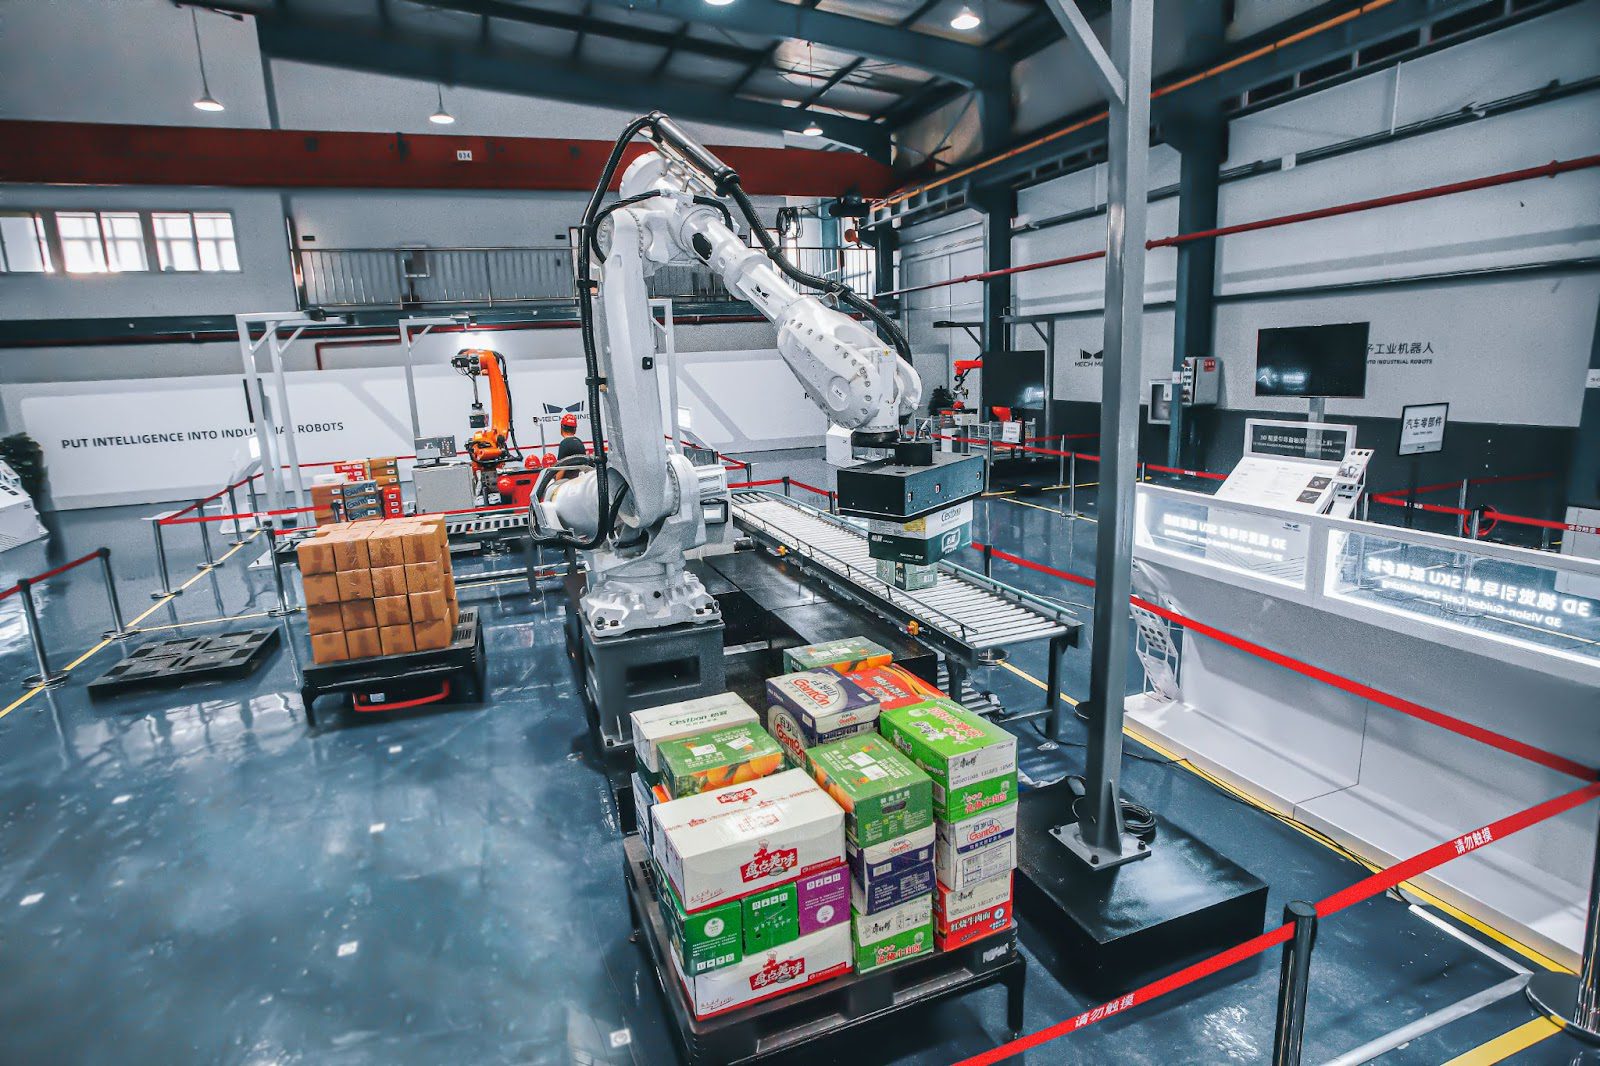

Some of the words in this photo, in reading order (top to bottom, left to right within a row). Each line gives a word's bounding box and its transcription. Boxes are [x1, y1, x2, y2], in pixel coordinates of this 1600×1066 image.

[61, 438, 89, 449] PUT
[92, 432, 184, 448] INTELLIGENCE
[187, 430, 218, 441] INTO
[297, 421, 344, 434] ROBOTS
[1405, 416, 1442, 430] 汽车零部件
[1453, 826, 1494, 855] 请勿触摸
[1075, 993, 1135, 1028] 请勿触摸
